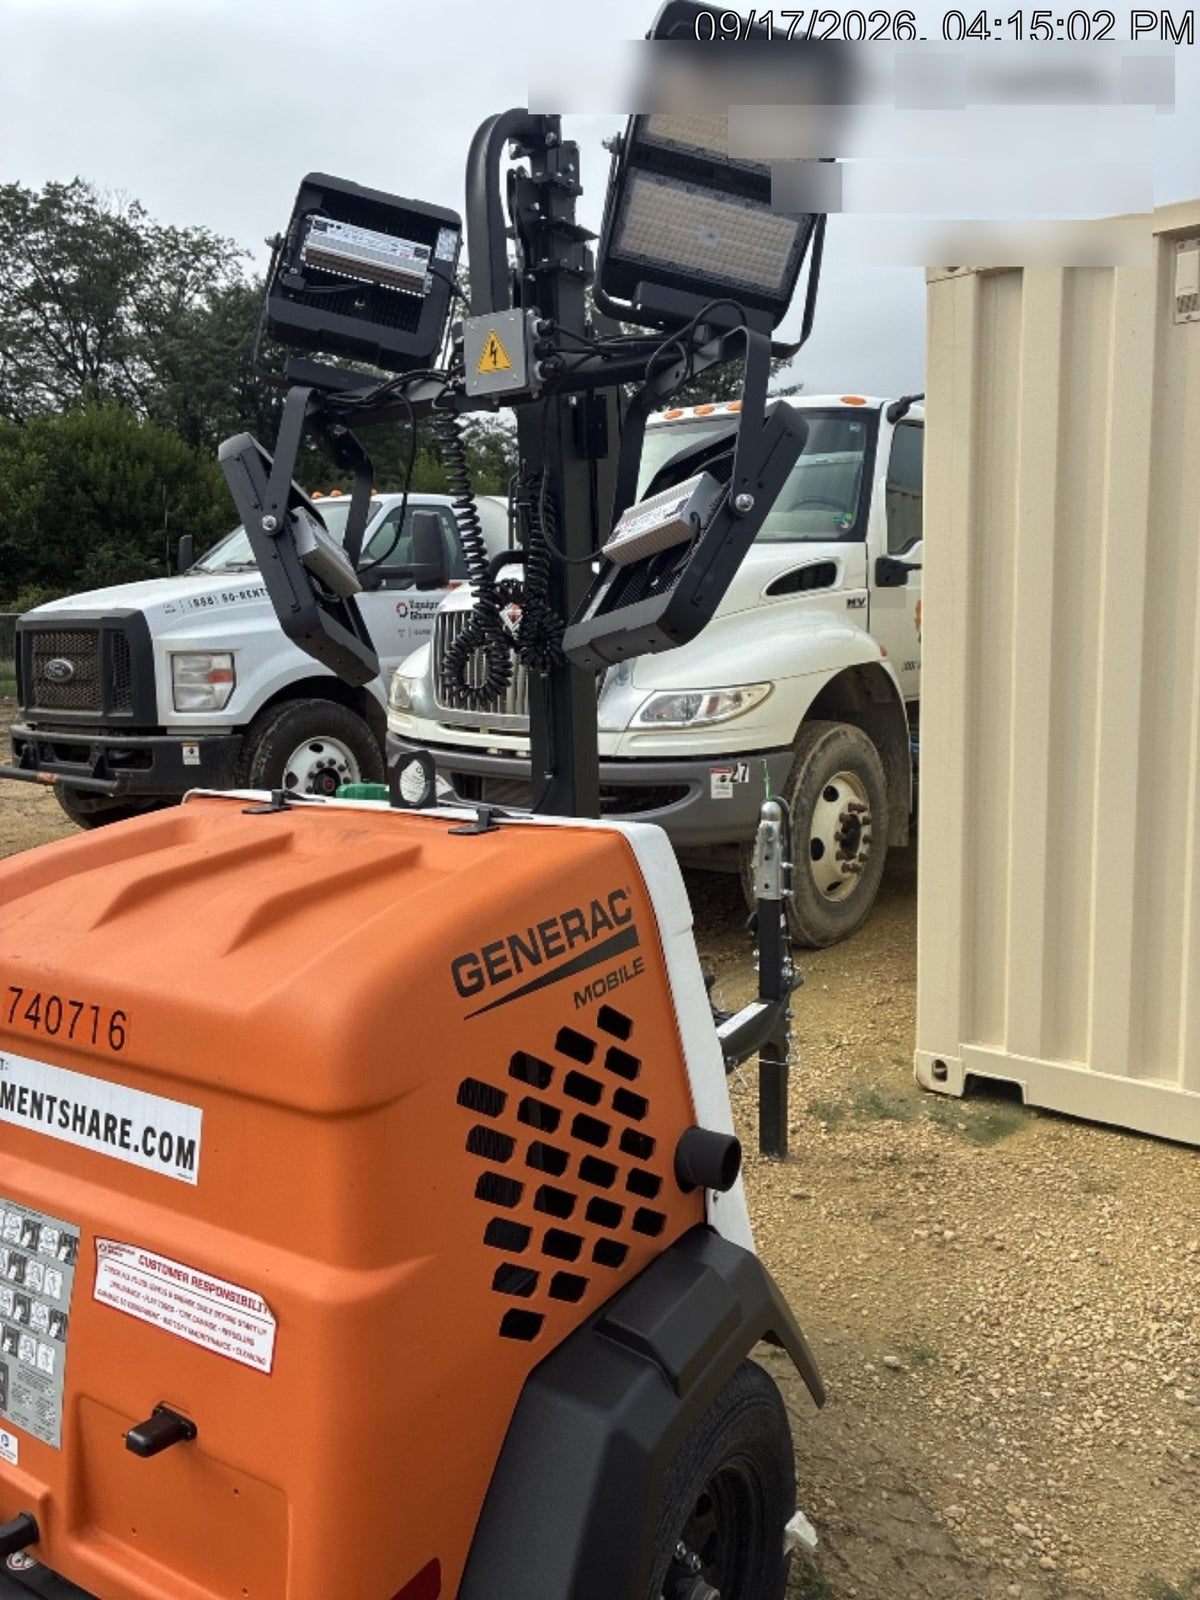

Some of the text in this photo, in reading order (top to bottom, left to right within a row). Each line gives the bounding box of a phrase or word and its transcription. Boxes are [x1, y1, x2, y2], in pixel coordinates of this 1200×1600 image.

[451, 888, 632, 998] GENERAC
[573, 956, 645, 1010] MOBILE
[8, 986, 128, 1051] 740716
[138, 1254, 189, 1285] CUSTOMER
[191, 1275, 270, 1316] RESPONSIBILIT
